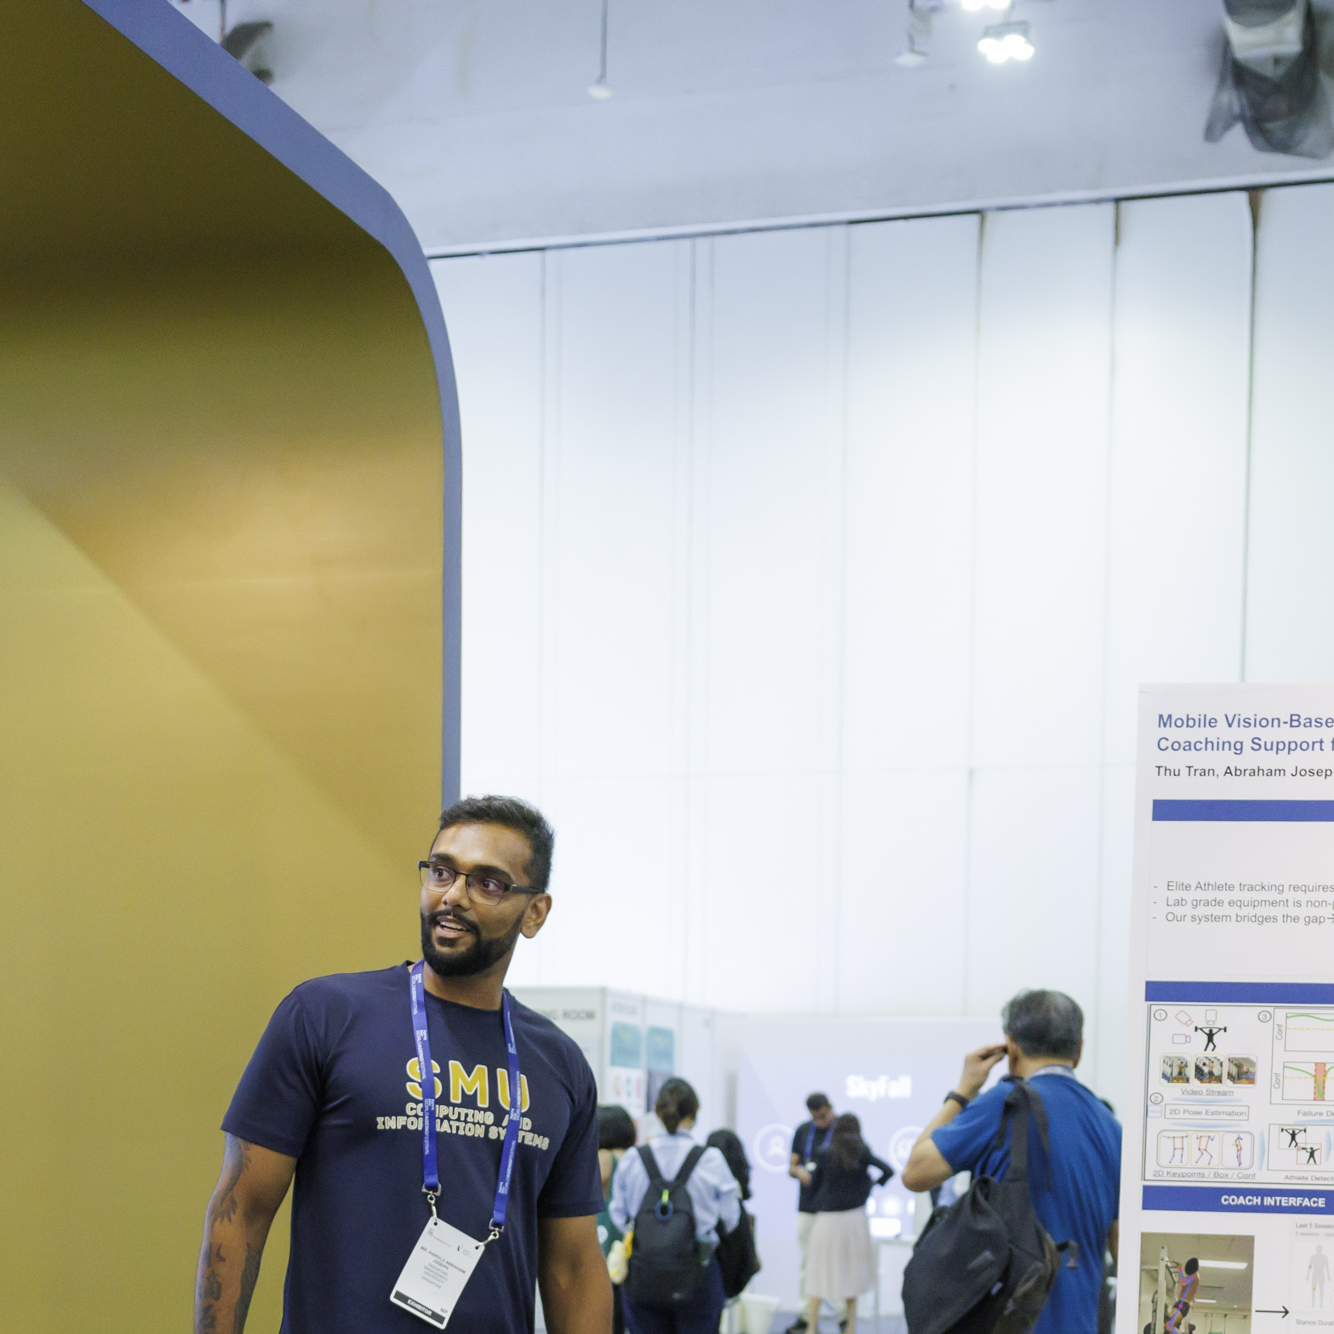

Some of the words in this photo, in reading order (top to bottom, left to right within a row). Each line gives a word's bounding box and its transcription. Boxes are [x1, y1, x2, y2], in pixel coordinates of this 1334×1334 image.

[1157, 713, 1218, 728] Mobile
[1156, 736, 1244, 755] Coaching
[1250, 737, 1325, 755] Support
[1155, 765, 1181, 777] Thu
[1185, 765, 1220, 779] Tran,
[1223, 765, 1286, 777] Abraham
[1167, 881, 1192, 892] Elite
[1195, 881, 1235, 892] Athlete
[1239, 882, 1284, 894] tracking
[405, 1056, 530, 1113] SMU
[405, 1102, 494, 1125] COPUTING
[488, 1125, 550, 1150] SYTEMS
[1221, 1195, 1261, 1205] COACH
[1263, 1196, 1326, 1207] INTERFACE
